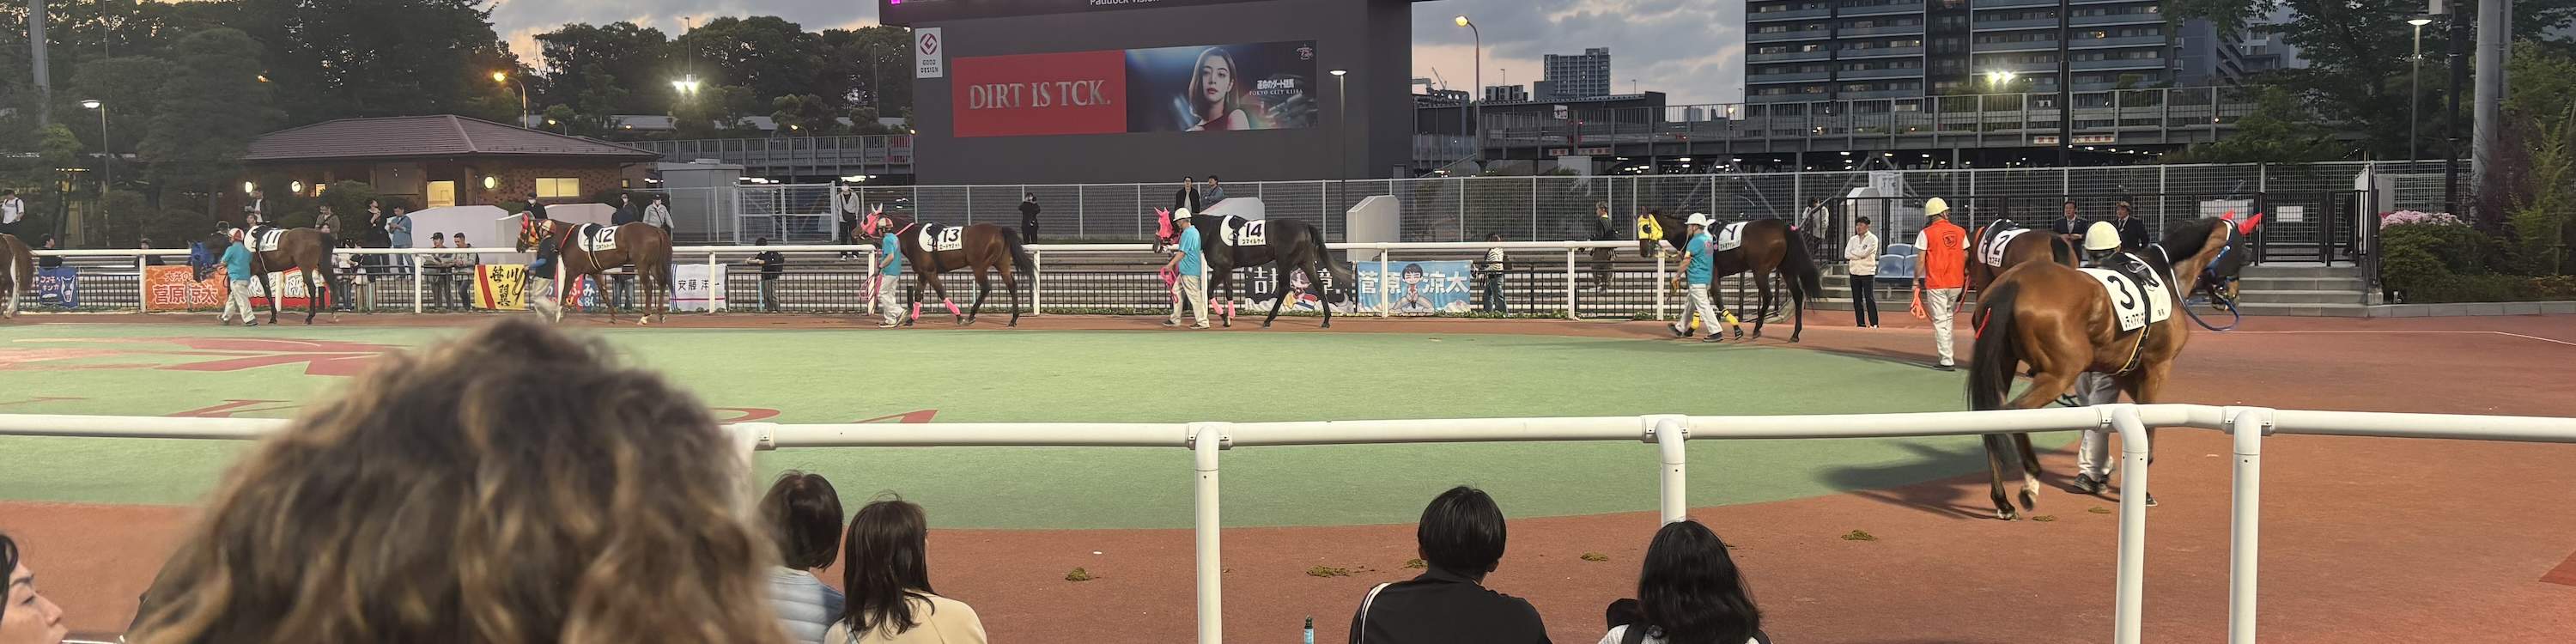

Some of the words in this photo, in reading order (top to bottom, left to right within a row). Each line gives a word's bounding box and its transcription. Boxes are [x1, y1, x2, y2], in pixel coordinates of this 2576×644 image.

[969, 82, 1024, 110] DIRT
[1031, 82, 1051, 107] IS
[1055, 79, 1111, 106] TCK.
[265, 231, 281, 244] 11
[598, 228, 614, 243] 12
[943, 228, 960, 243] 13
[1246, 222, 1262, 238] 14
[1993, 234, 2010, 255] 2
[2106, 275, 2136, 310] 3
